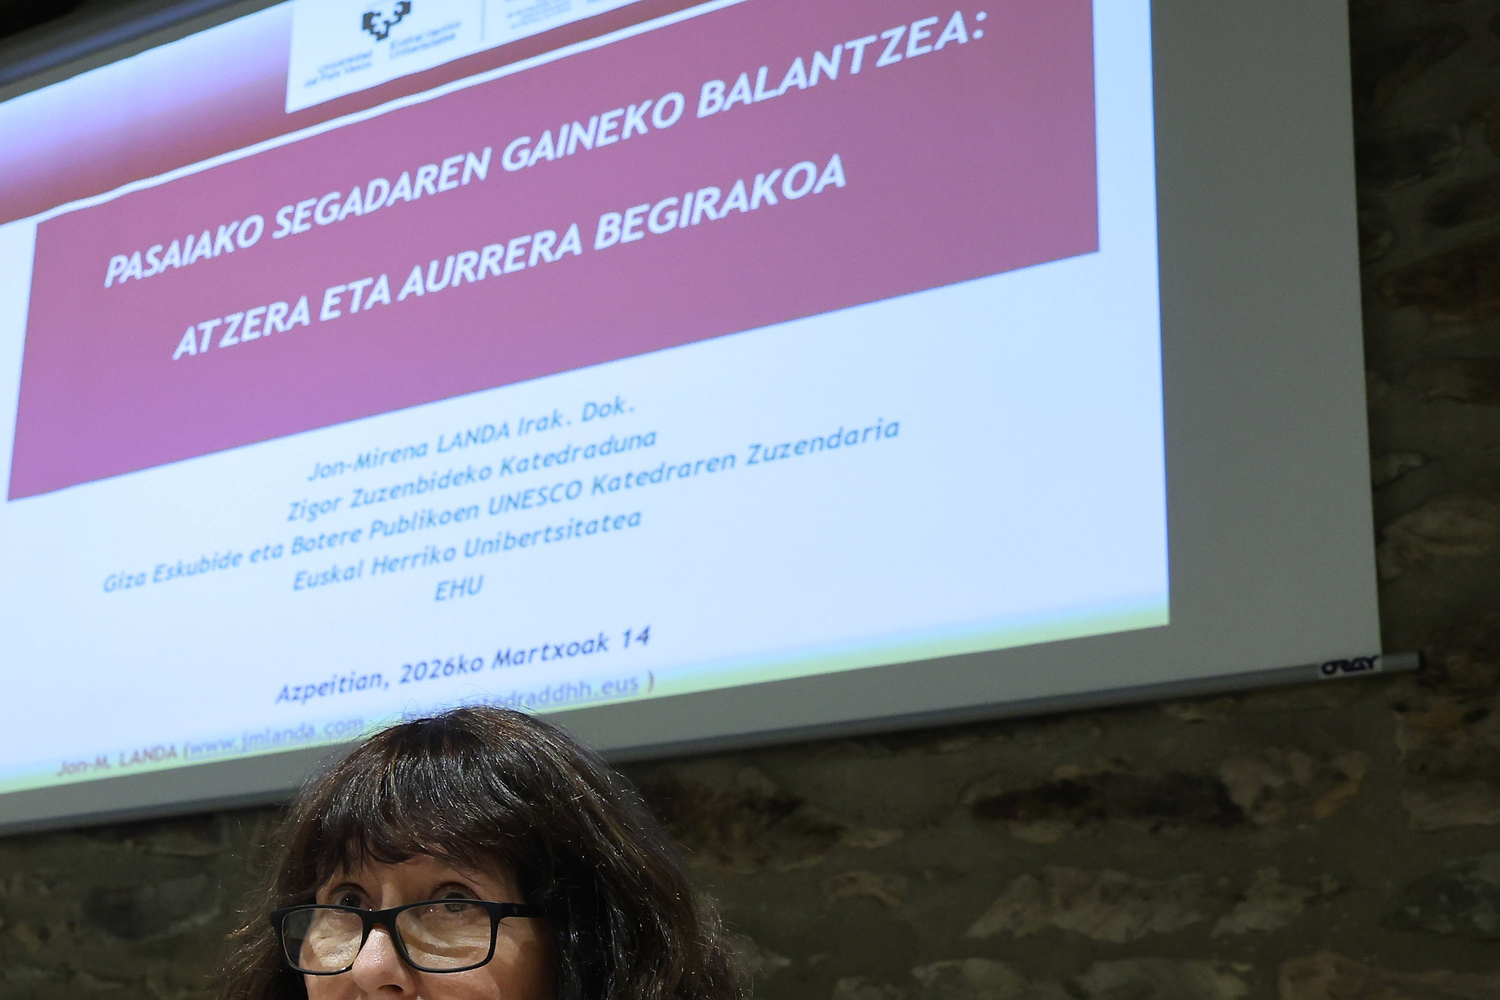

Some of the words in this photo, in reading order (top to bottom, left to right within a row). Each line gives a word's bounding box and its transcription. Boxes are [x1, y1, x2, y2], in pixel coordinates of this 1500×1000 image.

[105, 215, 264, 288] PASAIAKO
[273, 147, 491, 239] SEGADAREN
[501, 92, 685, 172] GAINEKO
[697, 10, 986, 119] BALANTZEA:
[172, 295, 309, 360] ATZERA
[319, 275, 392, 322] ETA
[398, 222, 582, 302] AURRERA
[593, 153, 847, 251] BEGIRAKOA
[286, 494, 342, 524] Zigor
[349, 462, 492, 509] Zuzenbideko
[500, 428, 658, 477] Katedraduna
[307, 441, 429, 483] Jon-Mirena
[436, 420, 510, 455] LANDA
[517, 413, 572, 437] Irak.
[581, 395, 635, 423] Dok.
[103, 569, 147, 594] Giza
[153, 549, 244, 584] Eskubide
[249, 541, 284, 564] eta
[291, 526, 362, 556] Botere
[370, 502, 479, 540] Publikoen
[488, 480, 583, 518] UNESCO
[592, 452, 737, 496] Katedraren
[746, 418, 901, 467] Zuzendaria
[292, 560, 365, 591] Euskal
[371, 542, 457, 576] Herriko
[464, 509, 642, 559] Unibertsitatea
[435, 576, 484, 602] EHU
[276, 670, 391, 706] Azpeitian,
[400, 652, 484, 684] 2026ko
[491, 634, 608, 670] Martxoak
[622, 626, 652, 649] 14
[119, 745, 179, 768] LANDA
